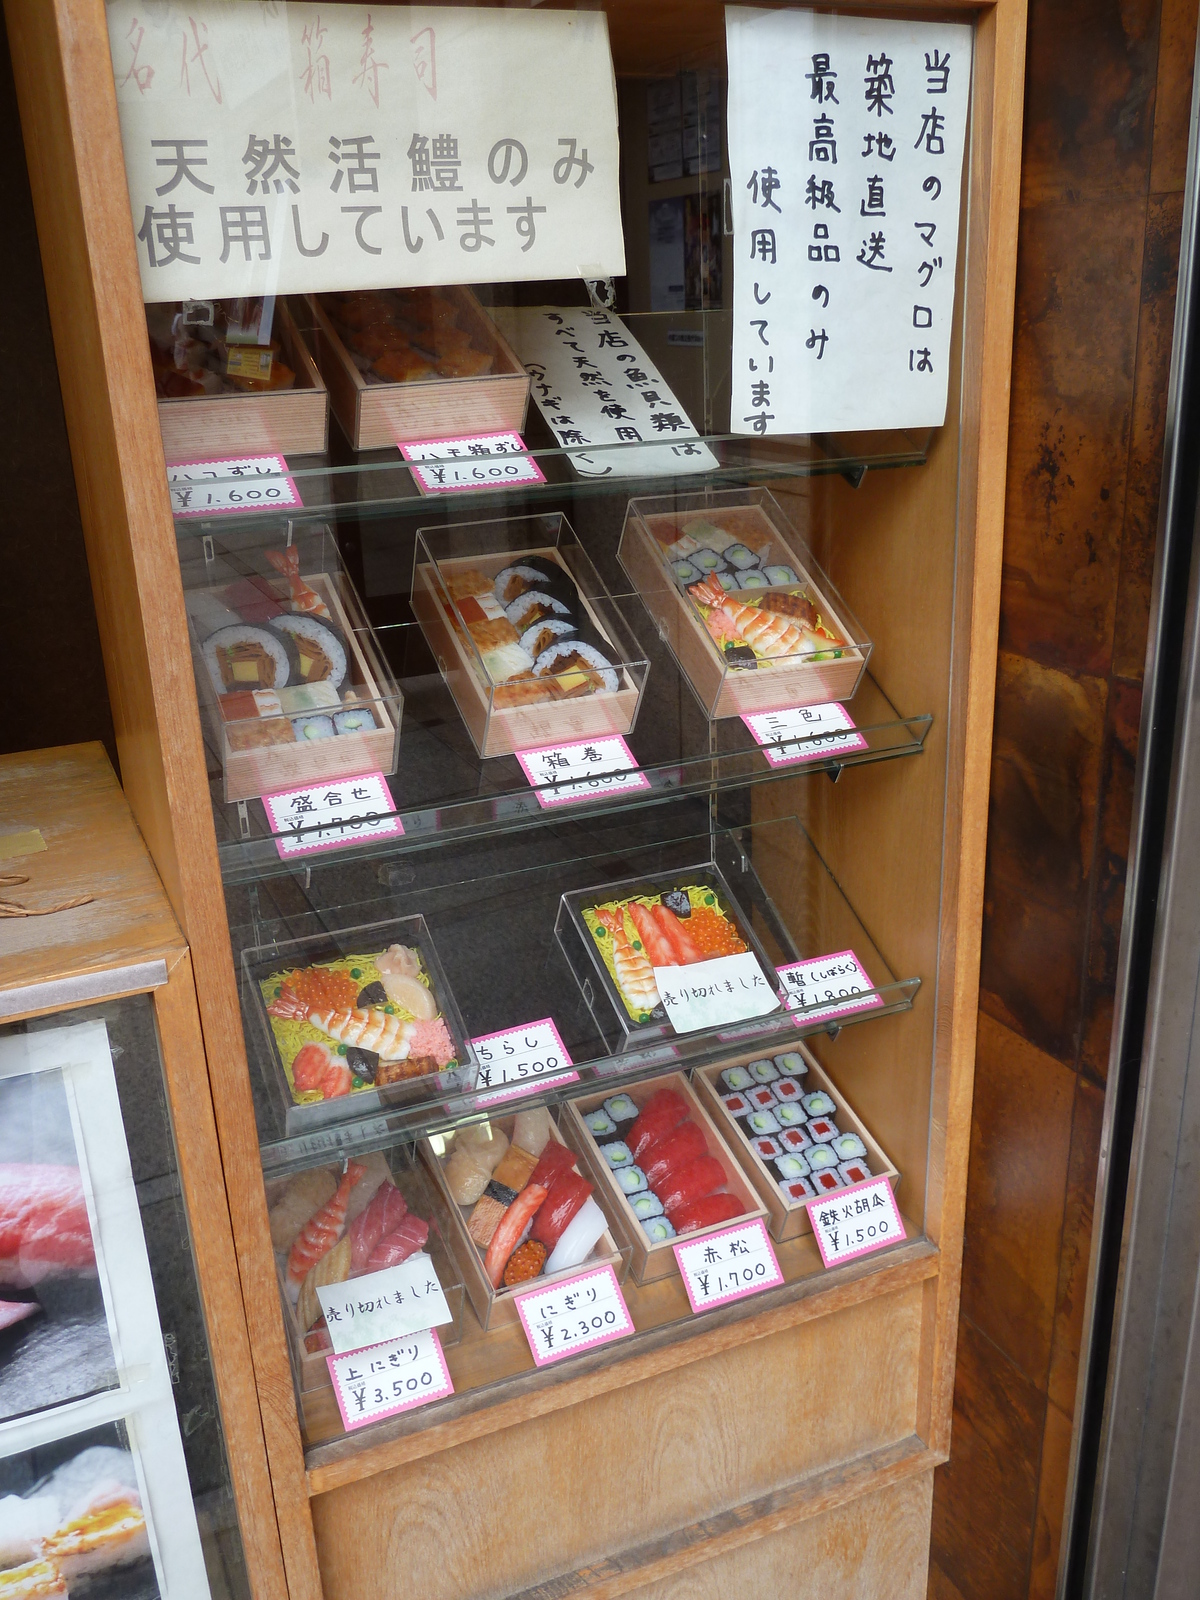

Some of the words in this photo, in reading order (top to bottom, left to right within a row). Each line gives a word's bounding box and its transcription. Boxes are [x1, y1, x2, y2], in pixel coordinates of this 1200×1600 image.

[150, 132, 595, 196] 天然活鱧のみ
[856, 53, 896, 272] 築地直送
[804, 53, 841, 360] 最高級品のみ
[908, 49, 951, 374] 当店のマグロは
[137, 197, 547, 268] 使用しています
[743, 166, 782, 436] 使用しています
[765, 709, 822, 729] 三色
[542, 746, 603, 769] 箱巻
[290, 787, 371, 814] 盛合せ
[663, 973, 766, 1007] 売り切れました
[476, 1037, 538, 1060] ちらし
[819, 1193, 886, 1227] 鉄火胡瓜
[703, 1239, 750, 1264] 赤松
[326, 1279, 439, 1323] 売り切れました
[540, 1288, 597, 1319] にぎり
[345, 1344, 419, 1381] 上にぎり
